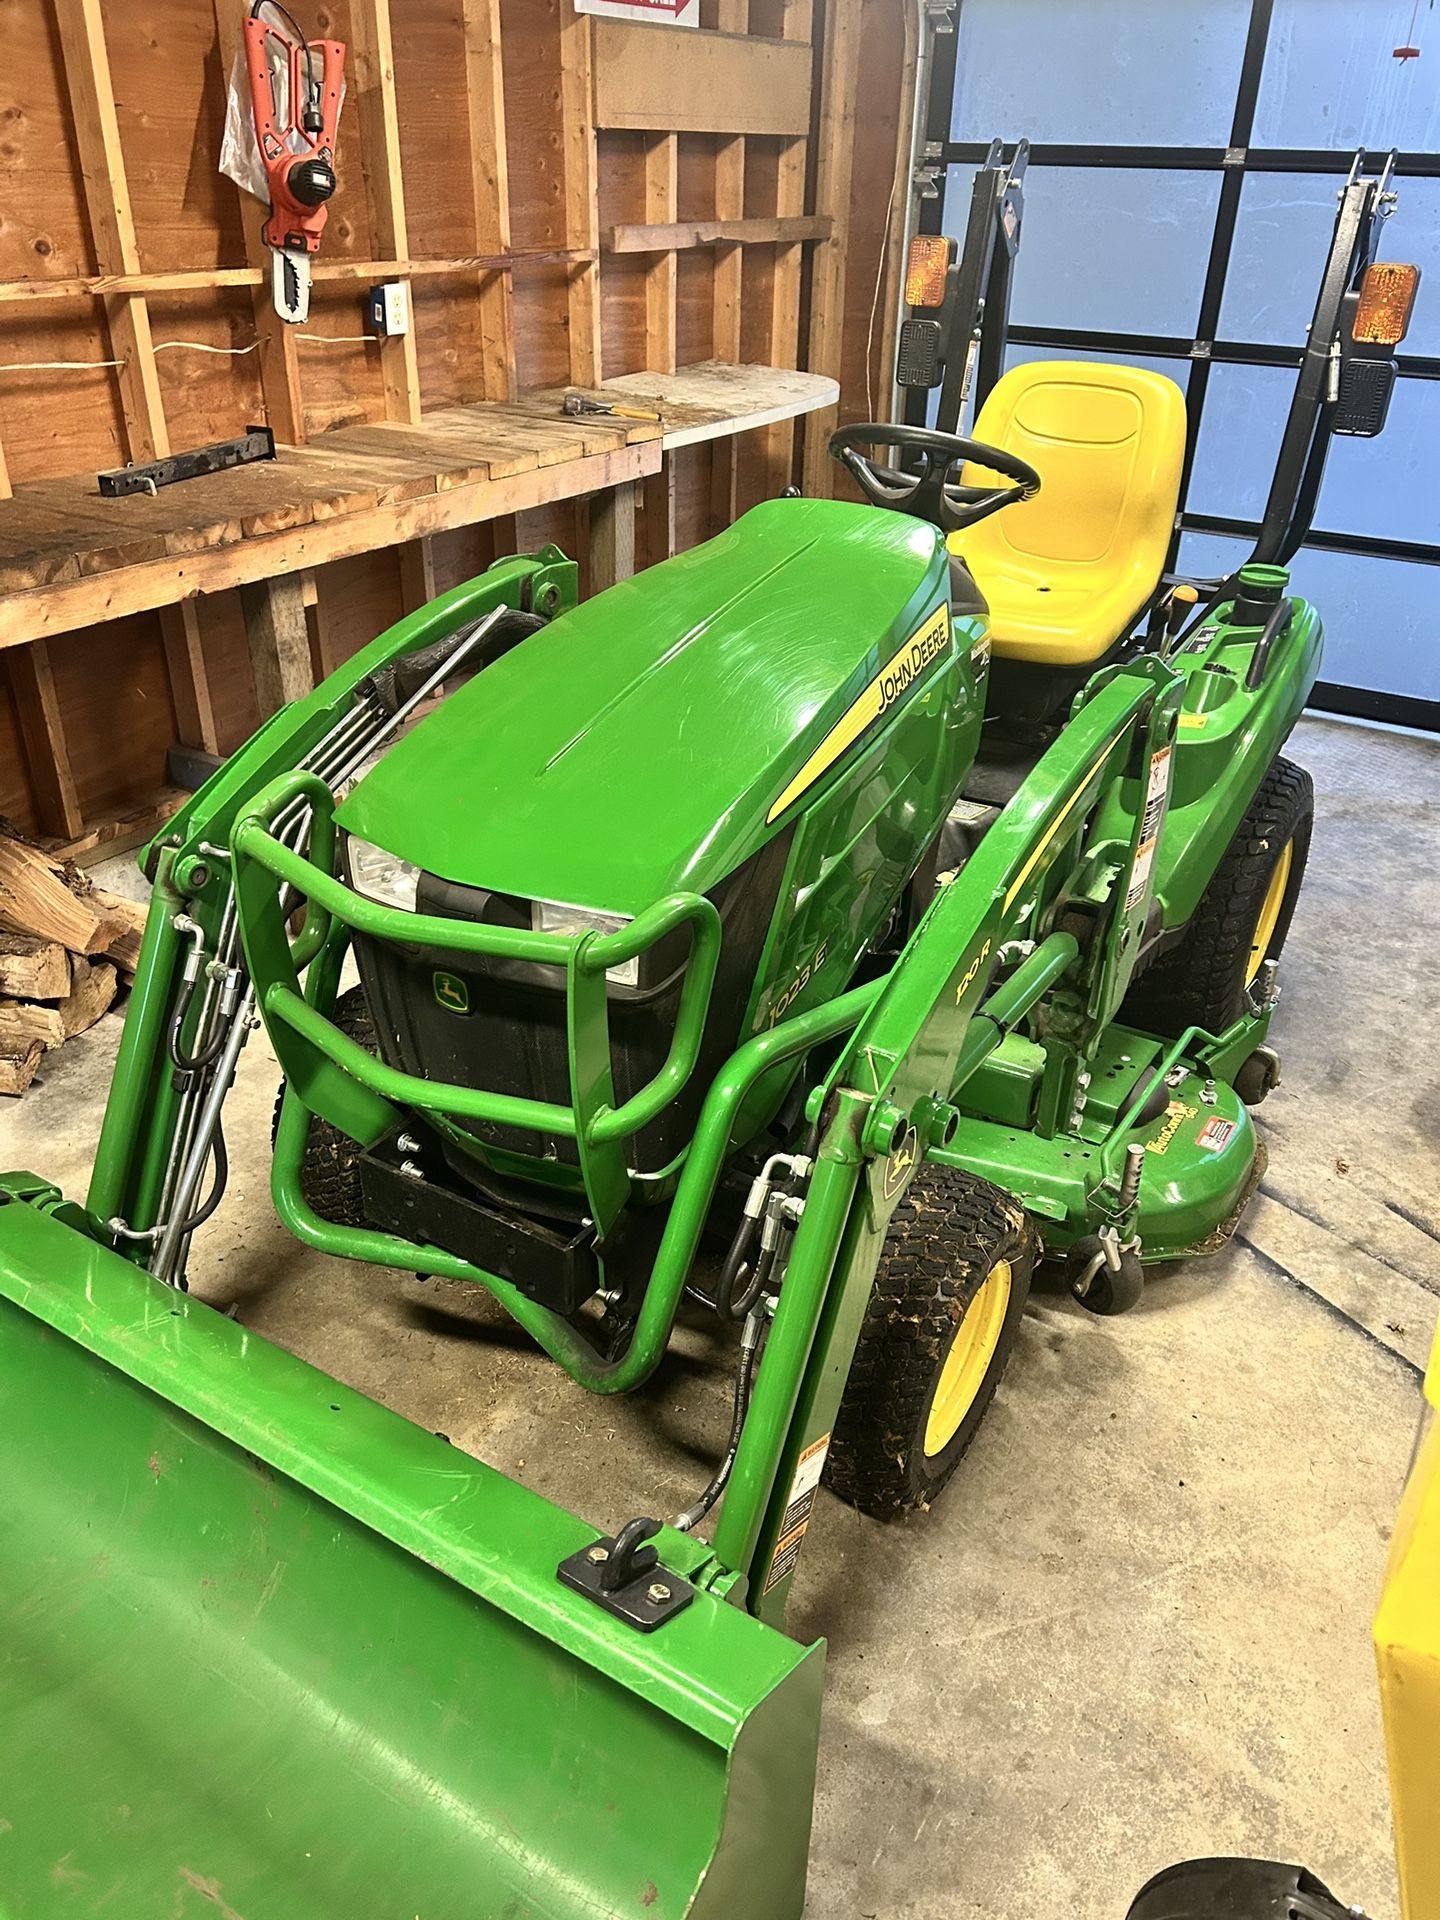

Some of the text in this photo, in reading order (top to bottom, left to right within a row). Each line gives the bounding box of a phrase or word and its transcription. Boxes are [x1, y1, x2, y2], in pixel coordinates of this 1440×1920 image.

[878, 622, 946, 711] JOHN DEERE
[769, 965, 811, 1029] 1023
